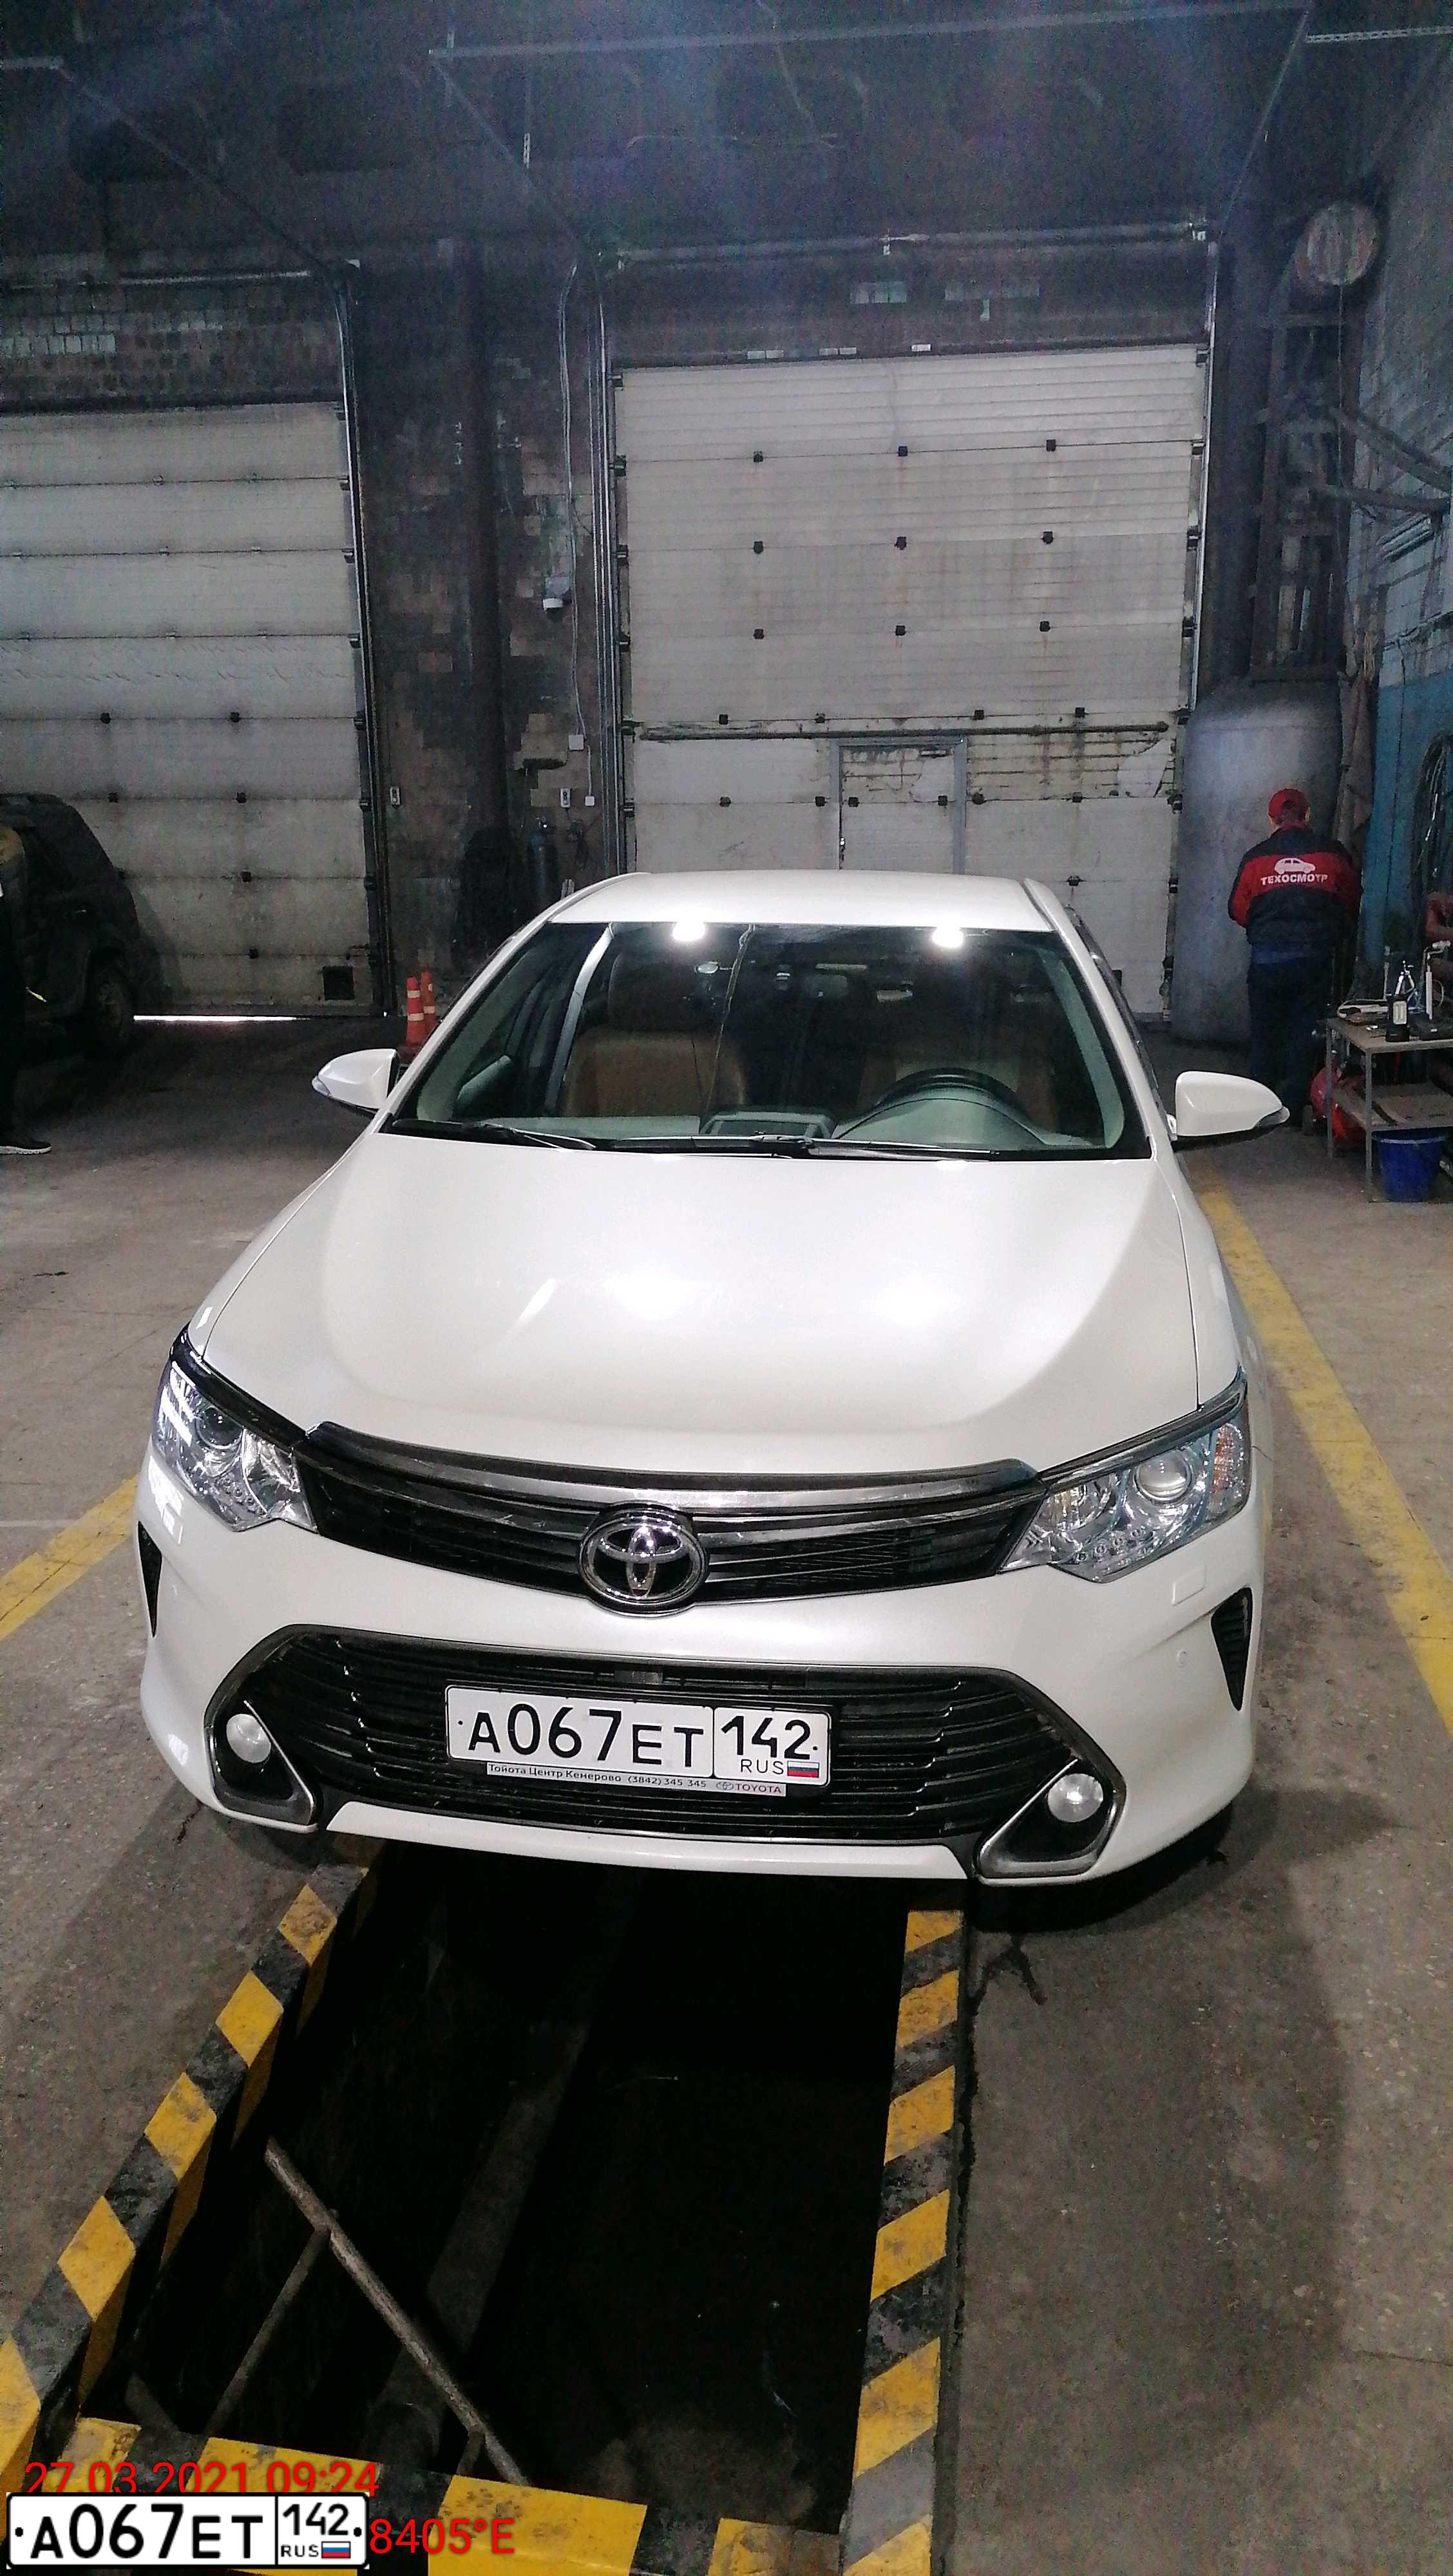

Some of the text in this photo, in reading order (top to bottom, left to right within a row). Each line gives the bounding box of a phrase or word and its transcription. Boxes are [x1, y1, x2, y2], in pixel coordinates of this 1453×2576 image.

[1260, 873, 1328, 886] ТЕХОСМОТР
[720, 1715, 811, 1760] 142
[489, 1764, 526, 1774] Тойота
[529, 1767, 563, 1778] Центр
[565, 1770, 622, 1782] Кемерово
[628, 1776, 661, 1786] (3842)
[664, 1778, 683, 1786] 345
[740, 1759, 784, 1775] RUS
[735, 1783, 782, 1794] TOYOTA
